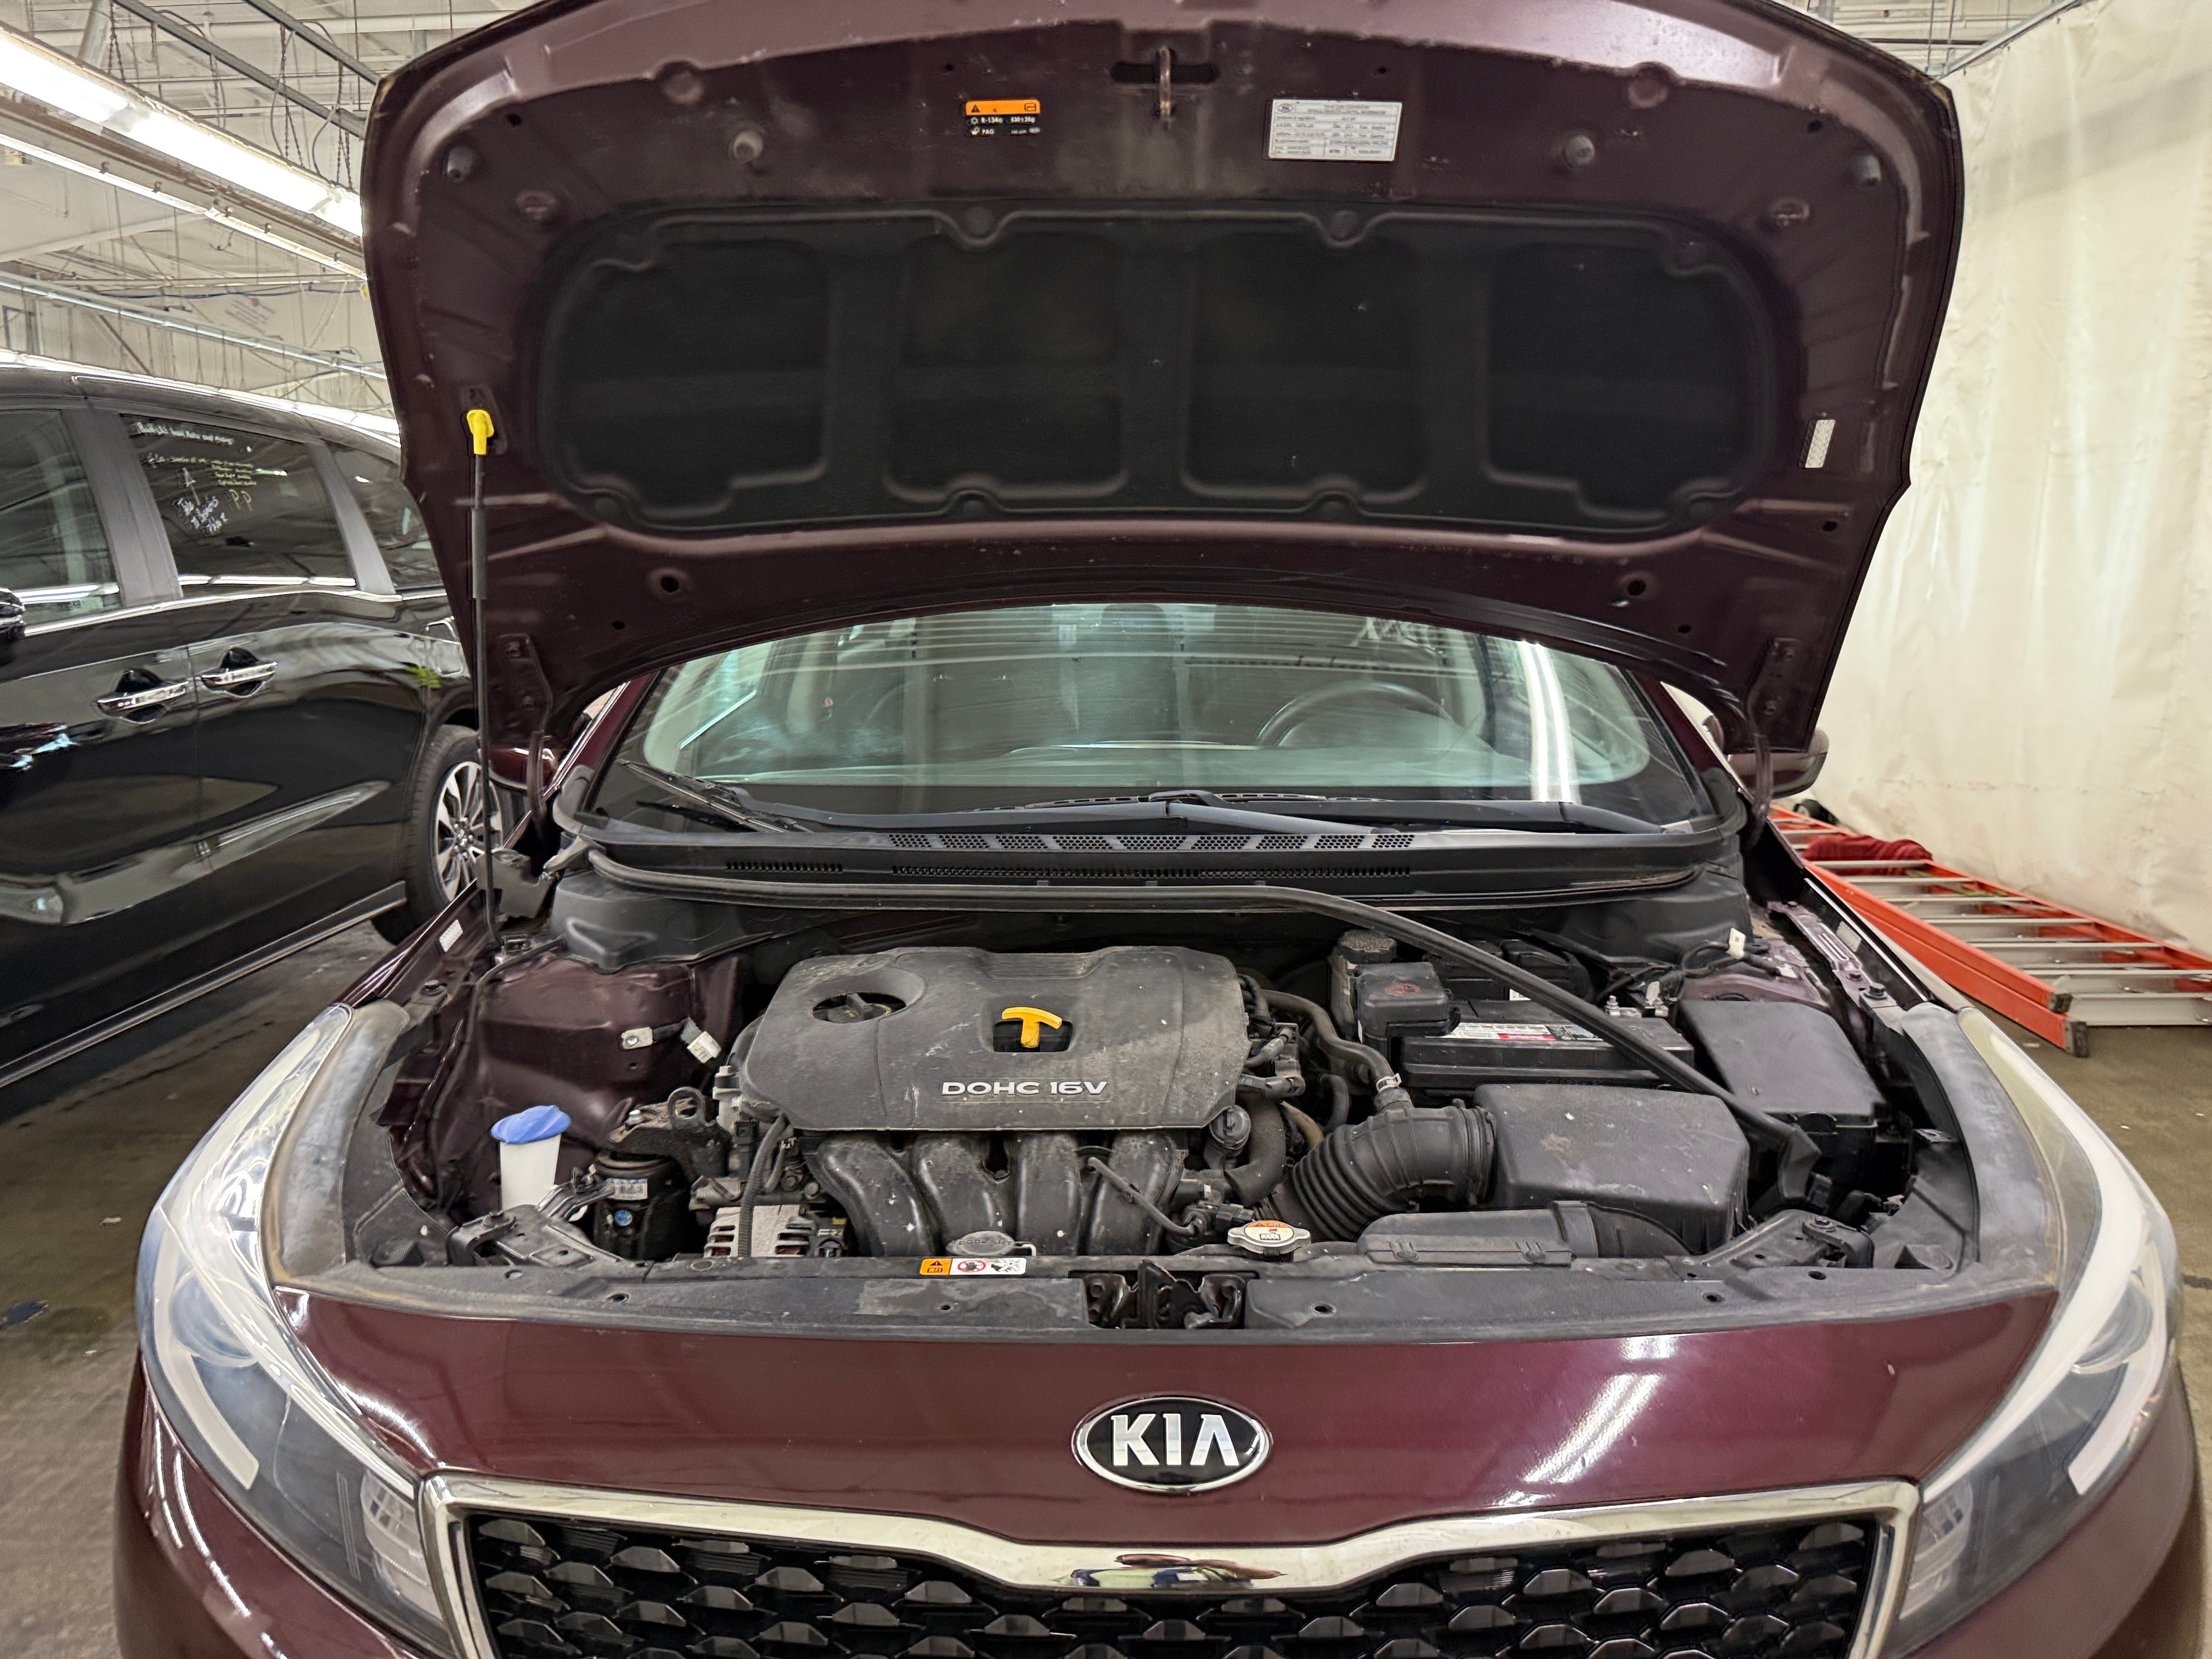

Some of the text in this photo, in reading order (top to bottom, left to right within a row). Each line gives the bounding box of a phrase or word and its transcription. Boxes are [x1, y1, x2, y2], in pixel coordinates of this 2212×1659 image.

[942, 1081, 1108, 1095] DOHC 16V
[1110, 1414, 1239, 1466] KIA
